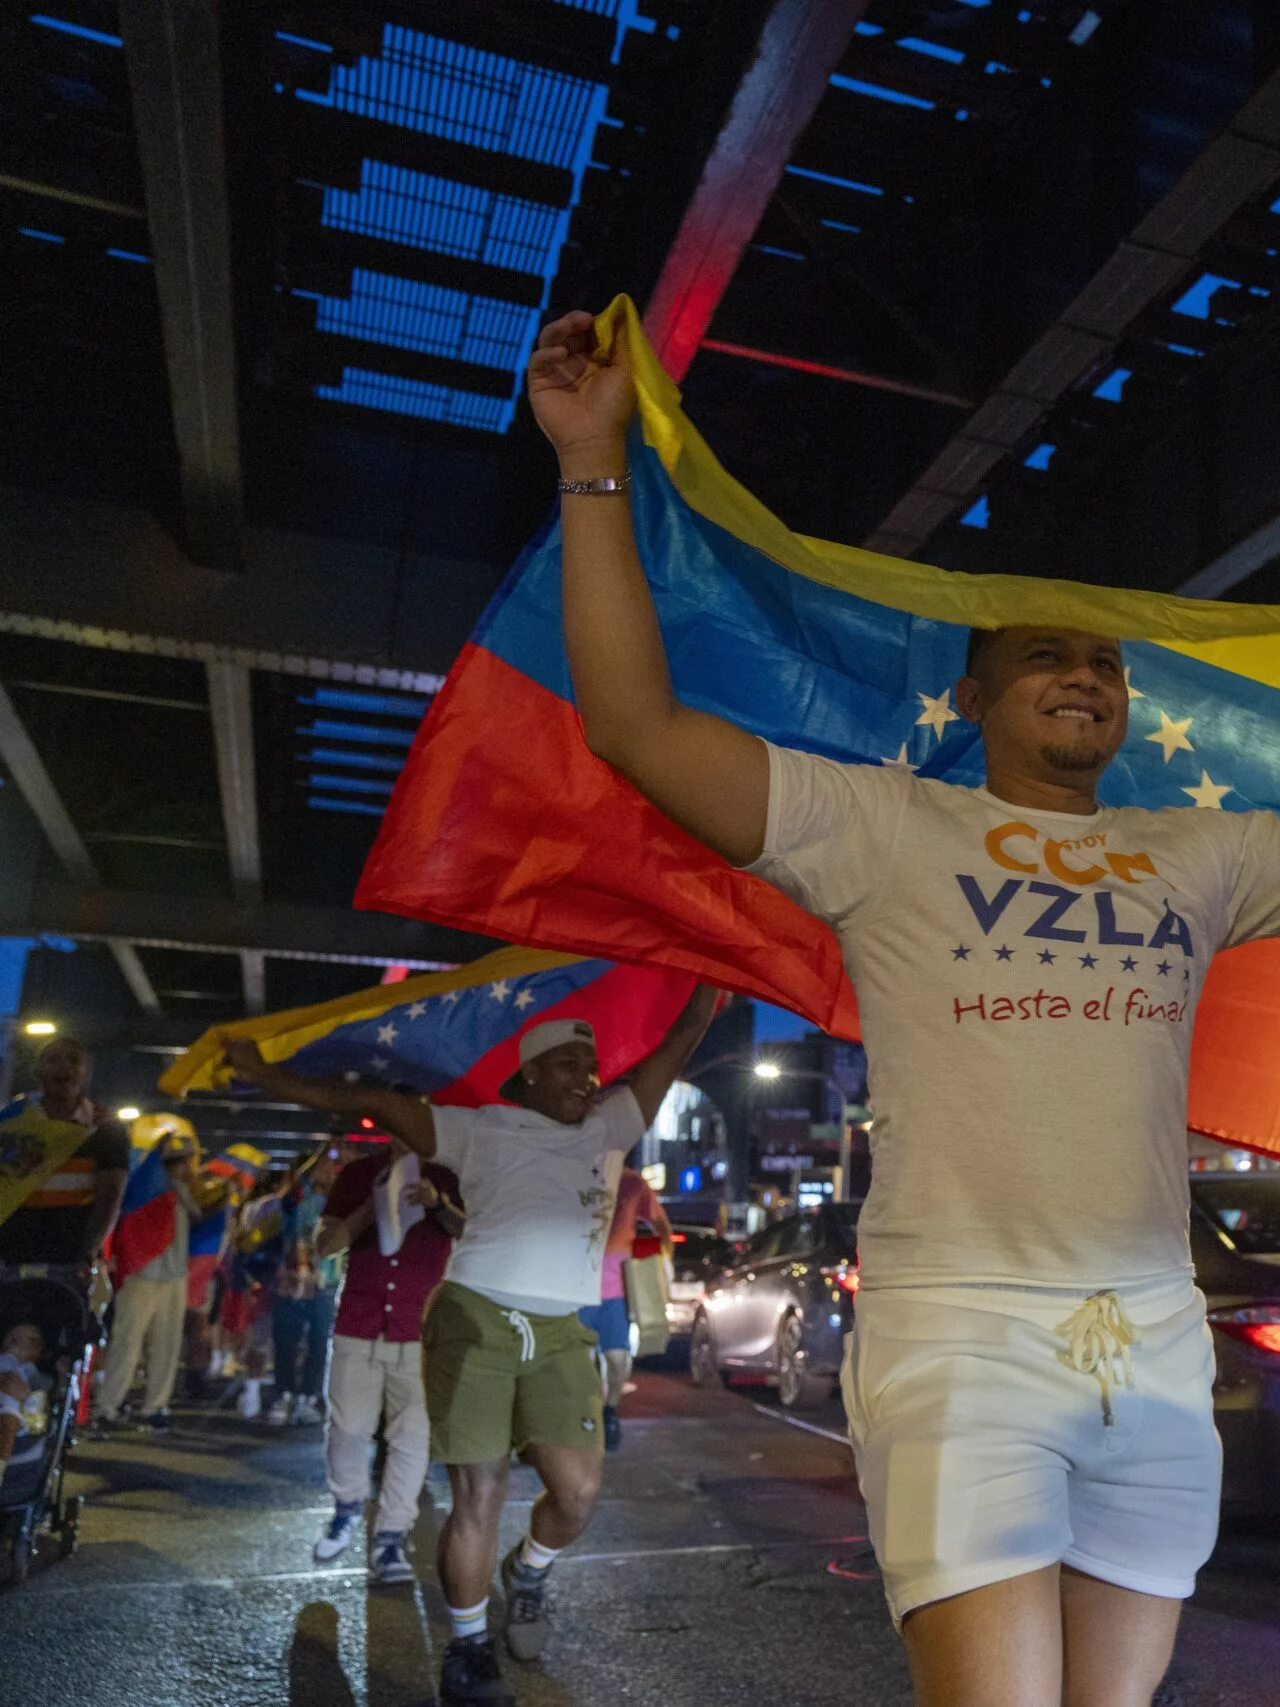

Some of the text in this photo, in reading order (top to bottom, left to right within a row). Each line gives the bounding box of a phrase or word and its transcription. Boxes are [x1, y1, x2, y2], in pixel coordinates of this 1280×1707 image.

[955, 874, 1194, 957] VZLA
[953, 987, 1186, 1026] Hasta el final
